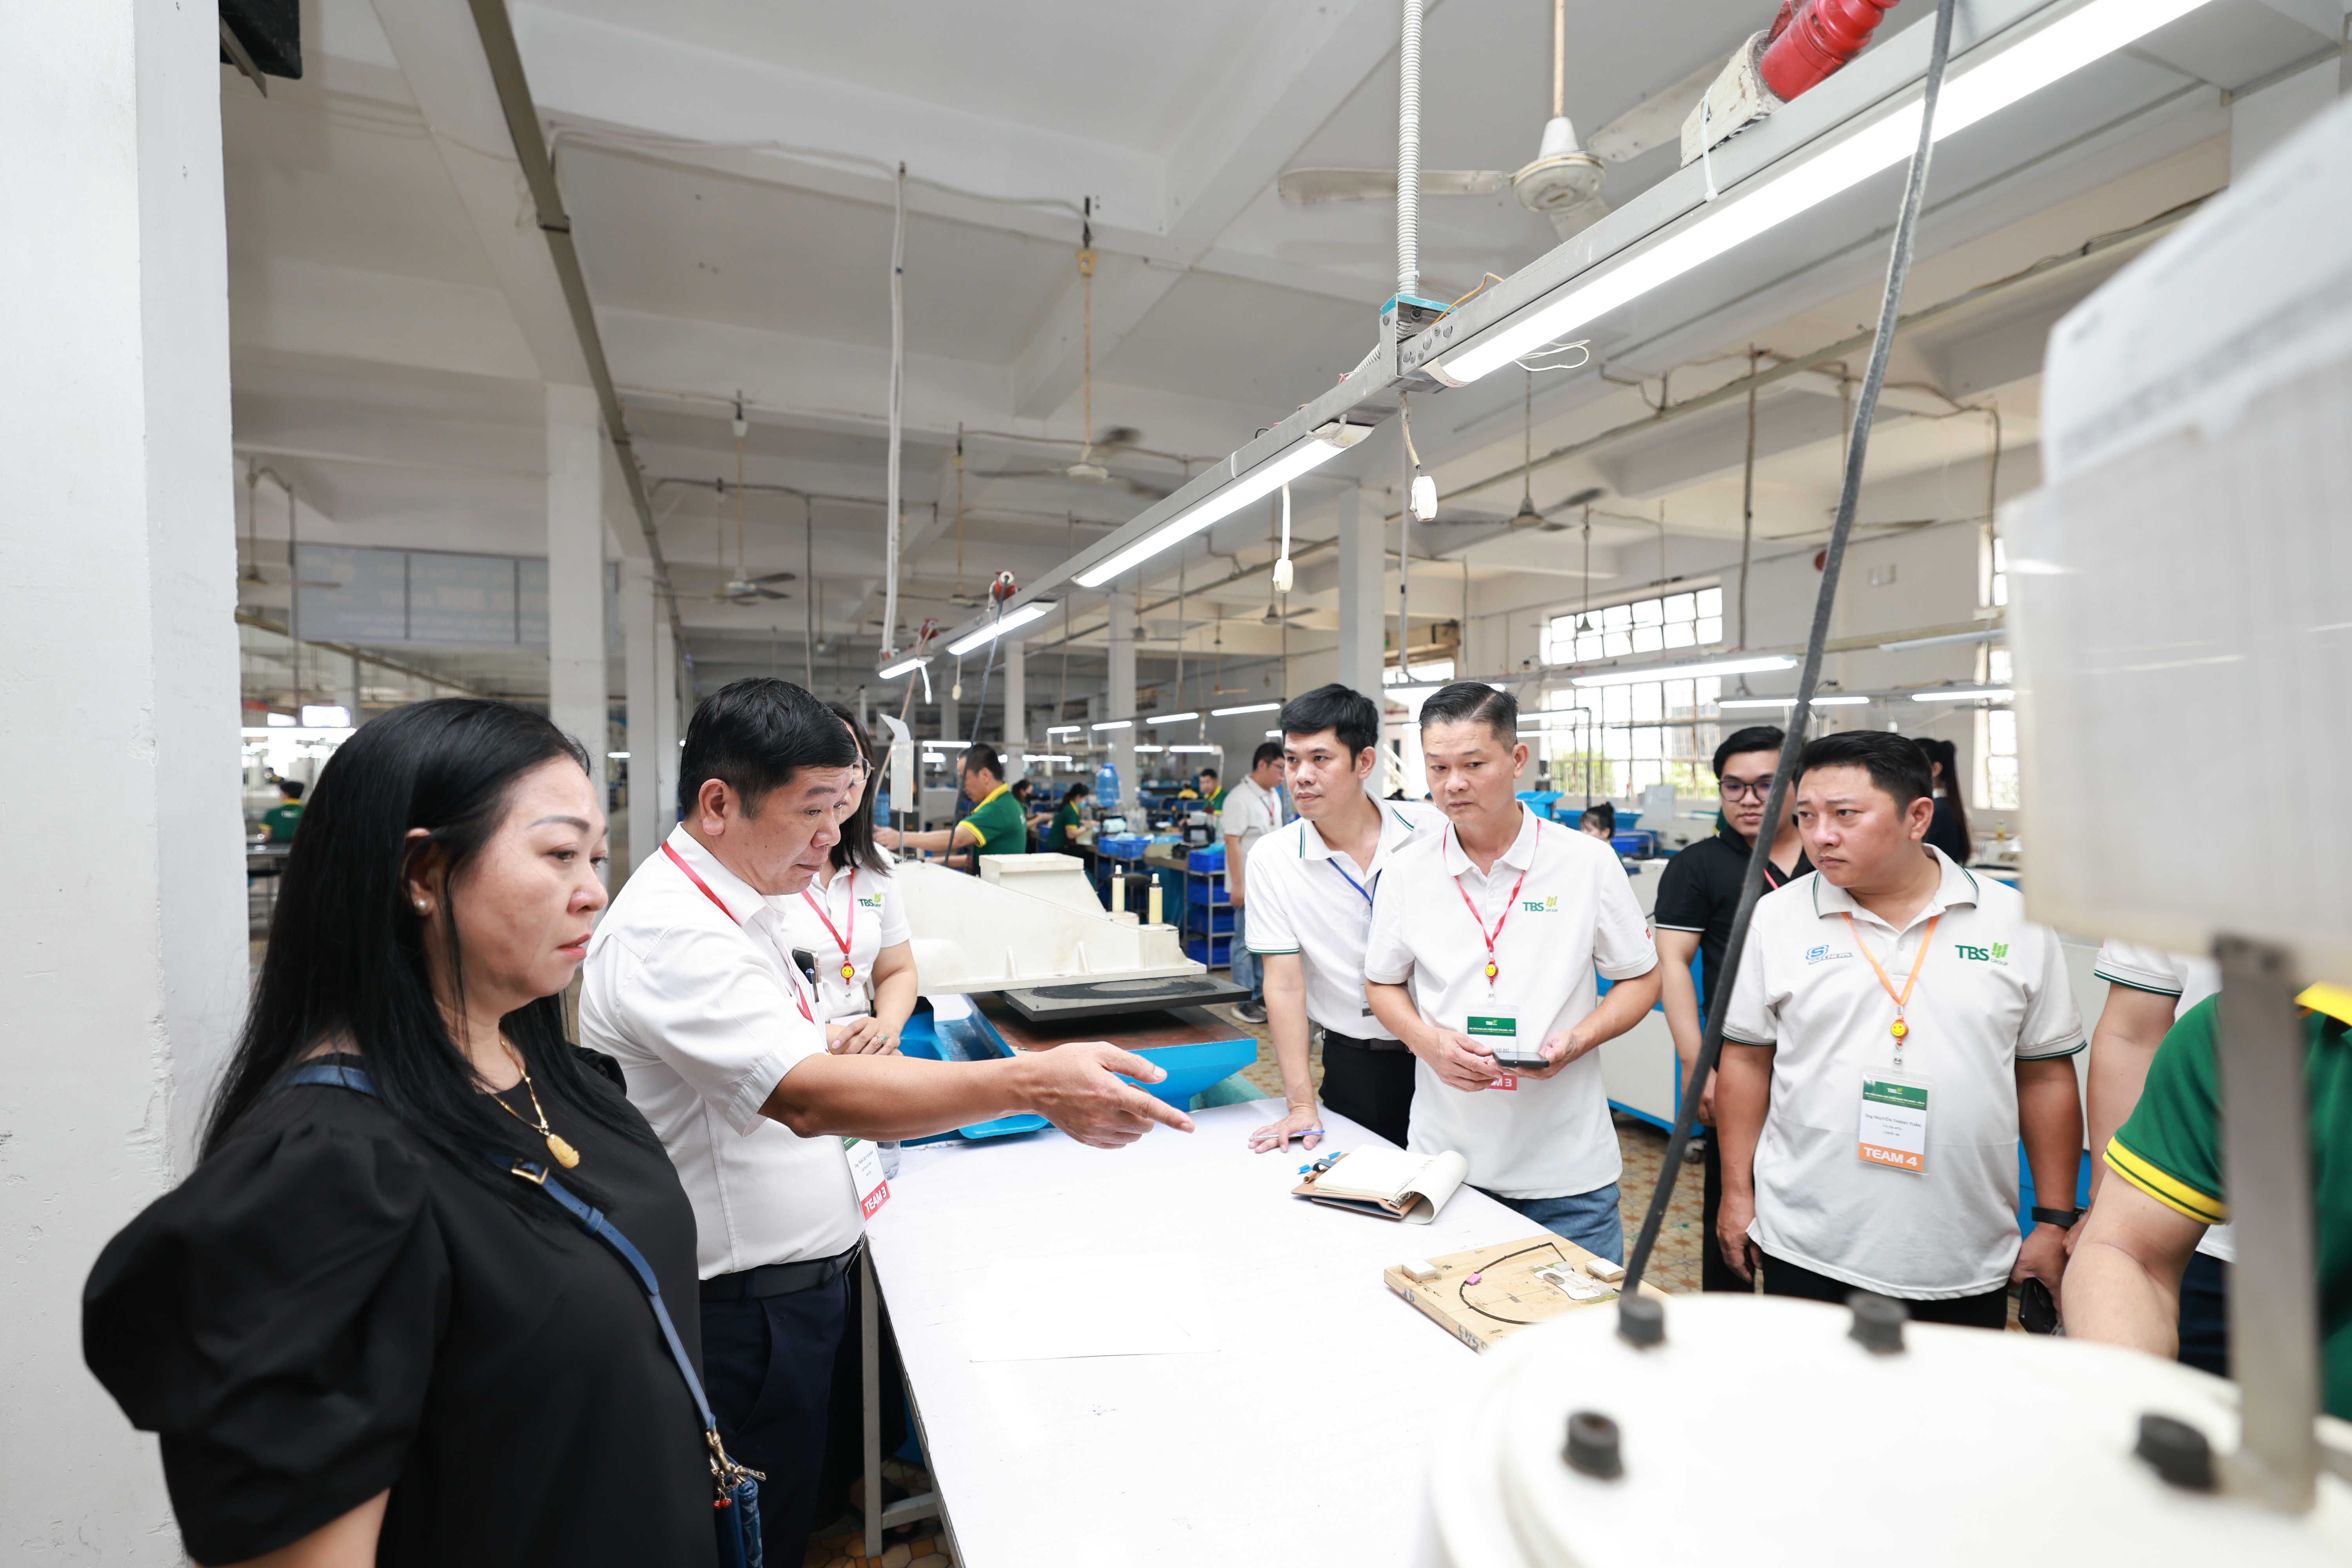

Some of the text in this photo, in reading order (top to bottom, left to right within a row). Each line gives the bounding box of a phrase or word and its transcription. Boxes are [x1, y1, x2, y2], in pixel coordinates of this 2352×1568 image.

[1523, 902, 1544, 911] TBS
[1808, 952, 1853, 965] SKECHERS
[1955, 945, 2009, 966] TBS GROUP
[1505, 1078, 1512, 1087] 3
[1864, 1147, 1918, 1167] TEAM 4
[864, 1186, 887, 1213] TEAM 3
